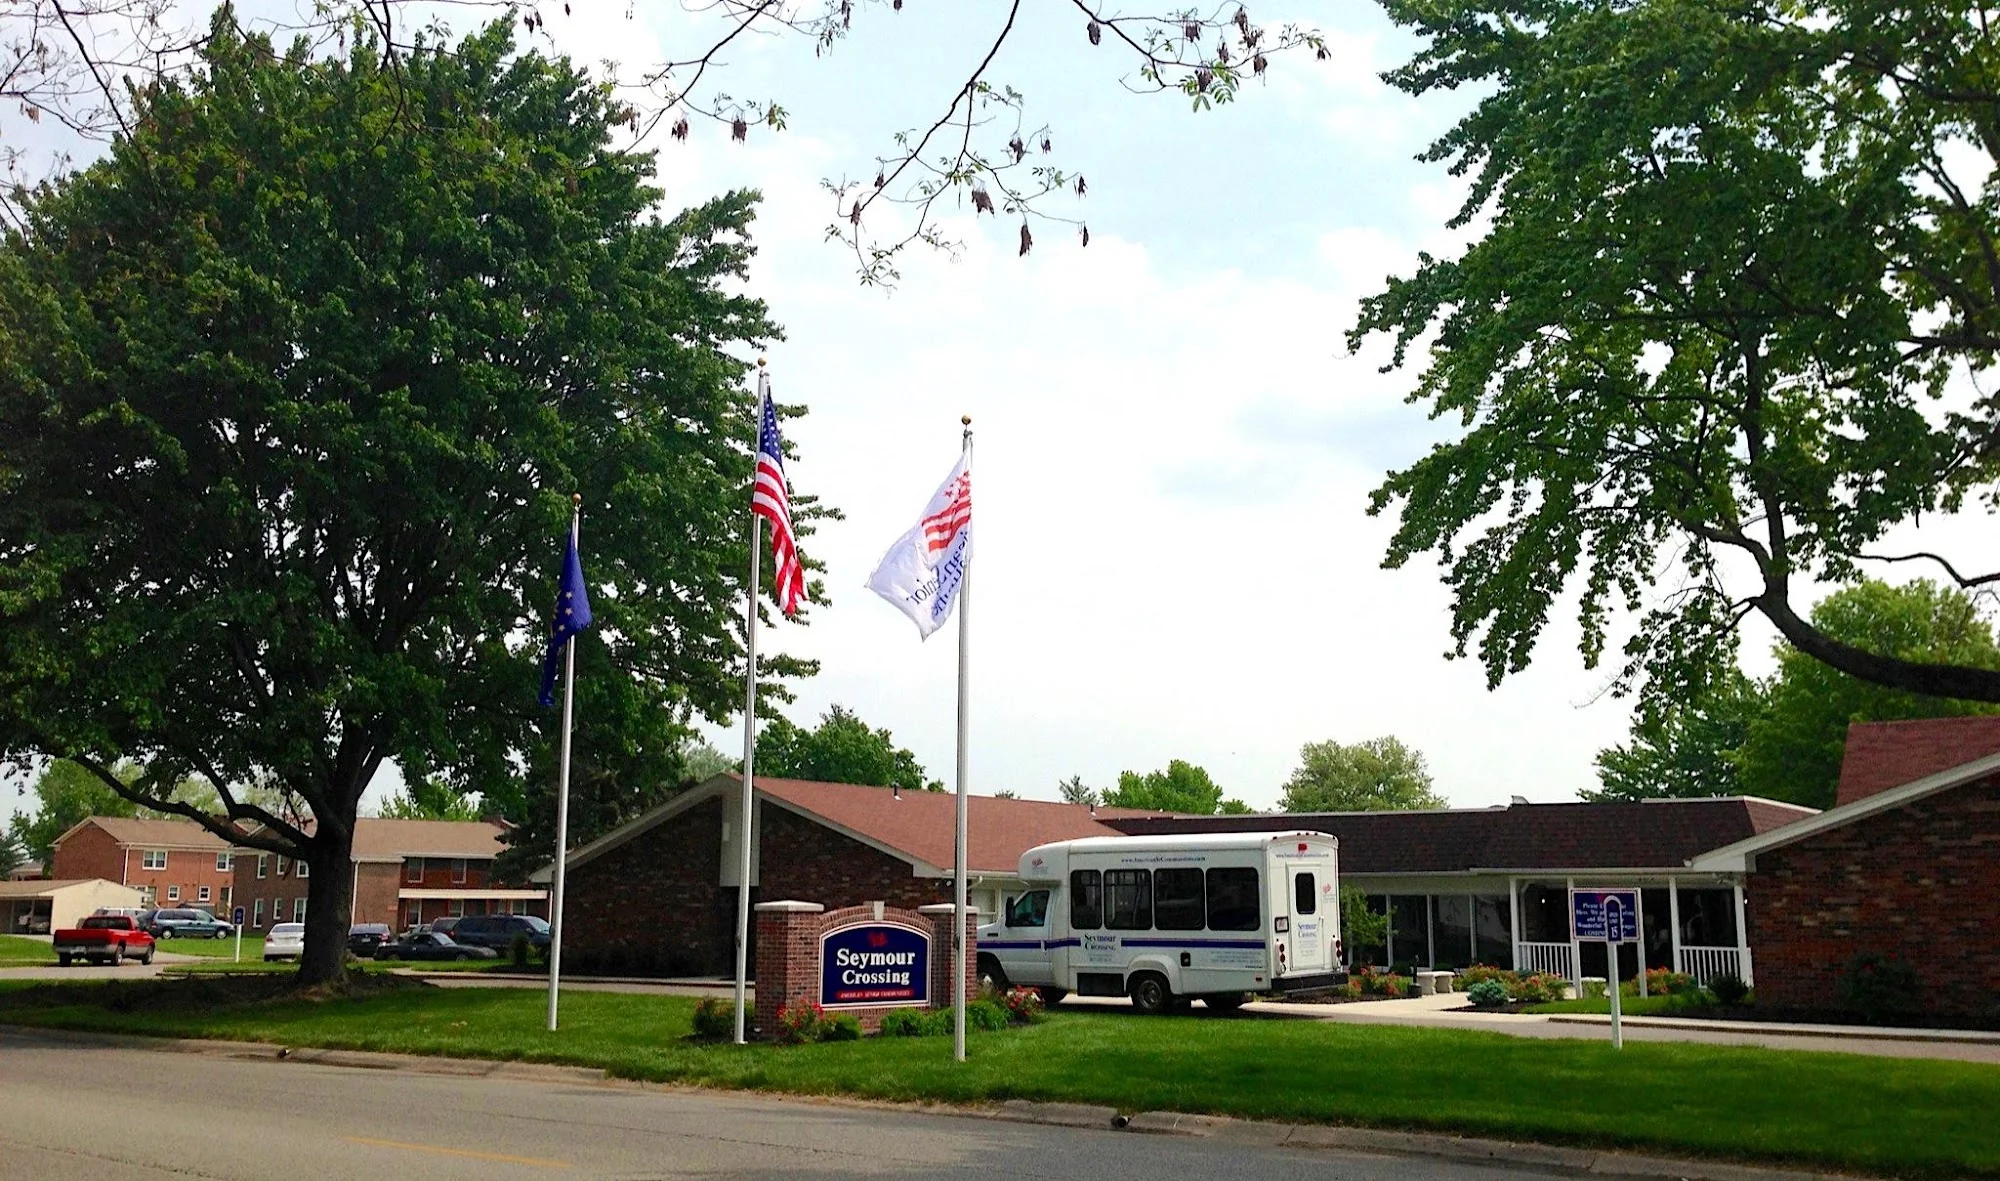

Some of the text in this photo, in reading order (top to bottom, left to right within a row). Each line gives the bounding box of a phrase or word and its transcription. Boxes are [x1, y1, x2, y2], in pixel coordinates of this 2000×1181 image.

[1611, 926, 1618, 938] 15
[836, 948, 915, 969] Seymour
[842, 969, 910, 985] Crossing
